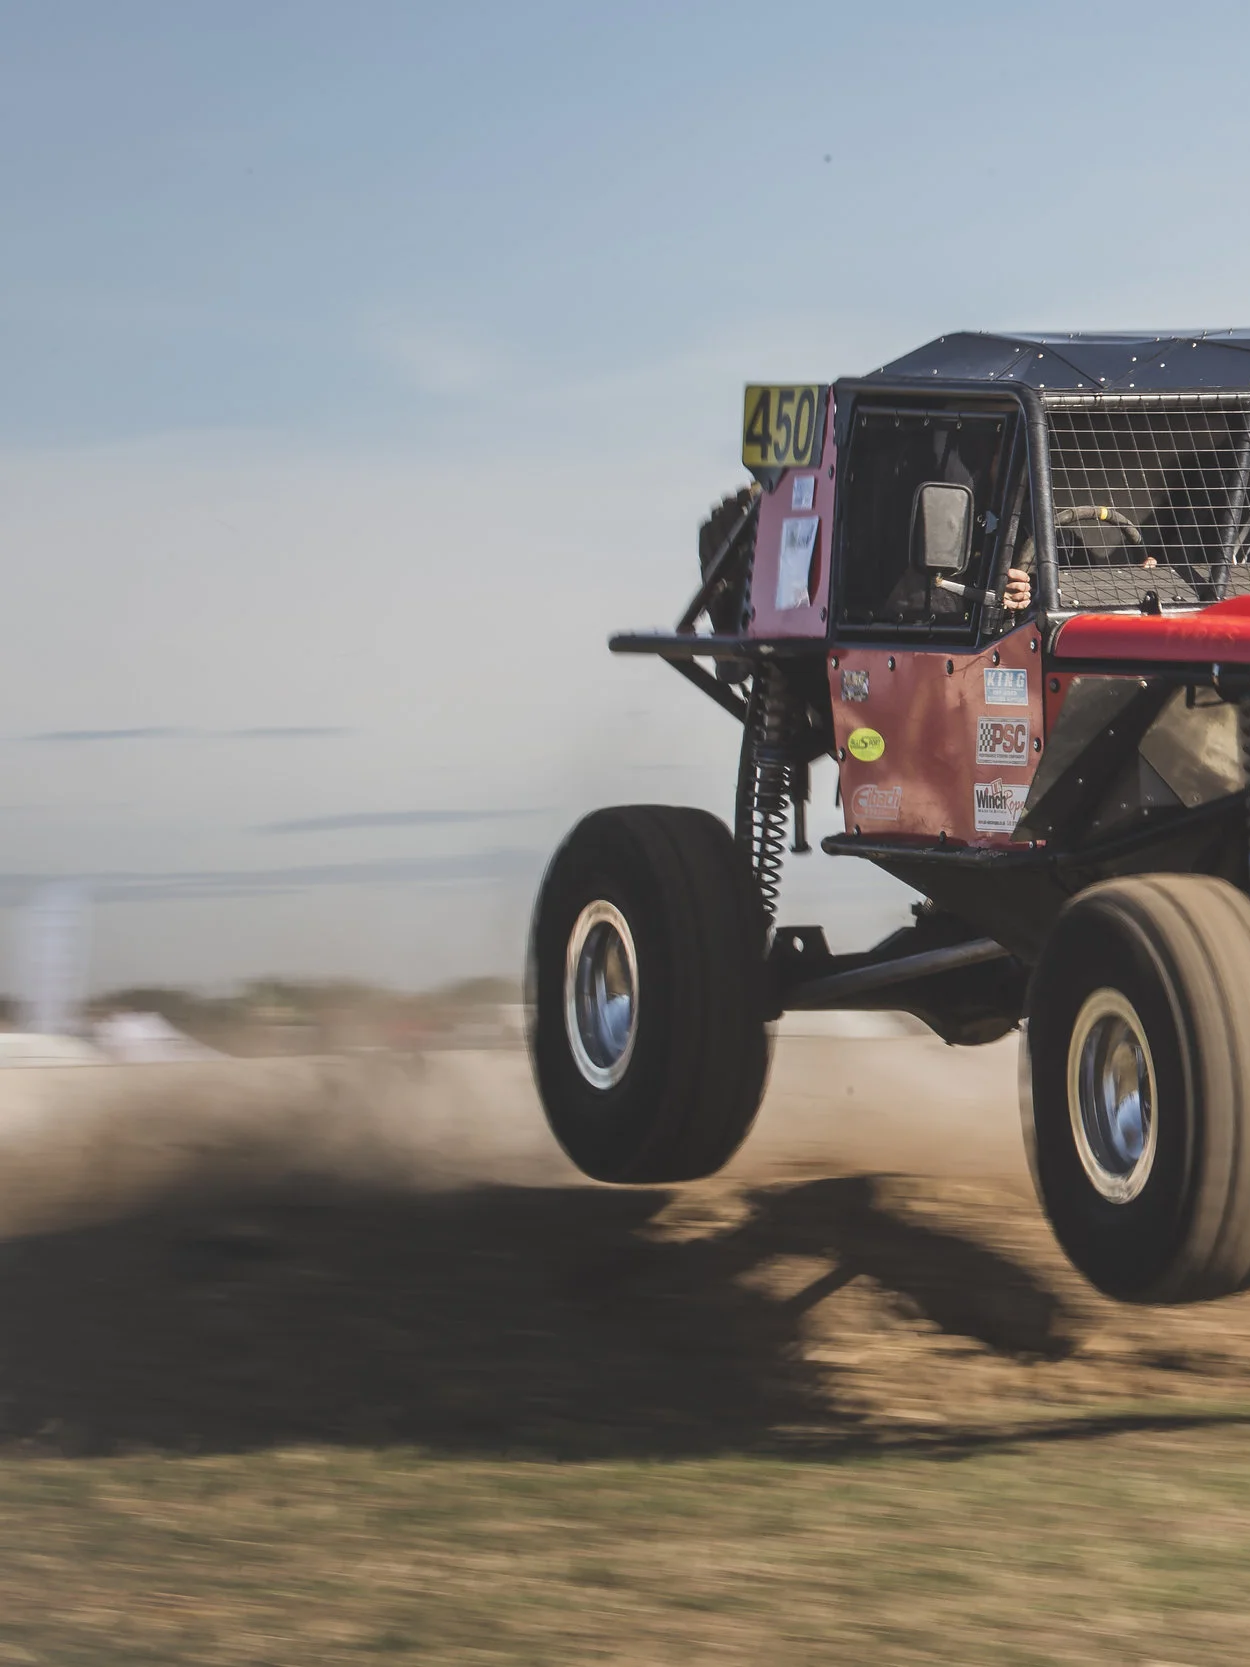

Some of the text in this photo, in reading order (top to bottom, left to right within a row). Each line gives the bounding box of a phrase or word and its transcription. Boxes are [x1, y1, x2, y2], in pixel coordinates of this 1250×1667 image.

[745, 388, 816, 462] 450
[987, 671, 1026, 688] KING
[990, 723, 1026, 753] PSC
[976, 787, 1007, 810] Winch
